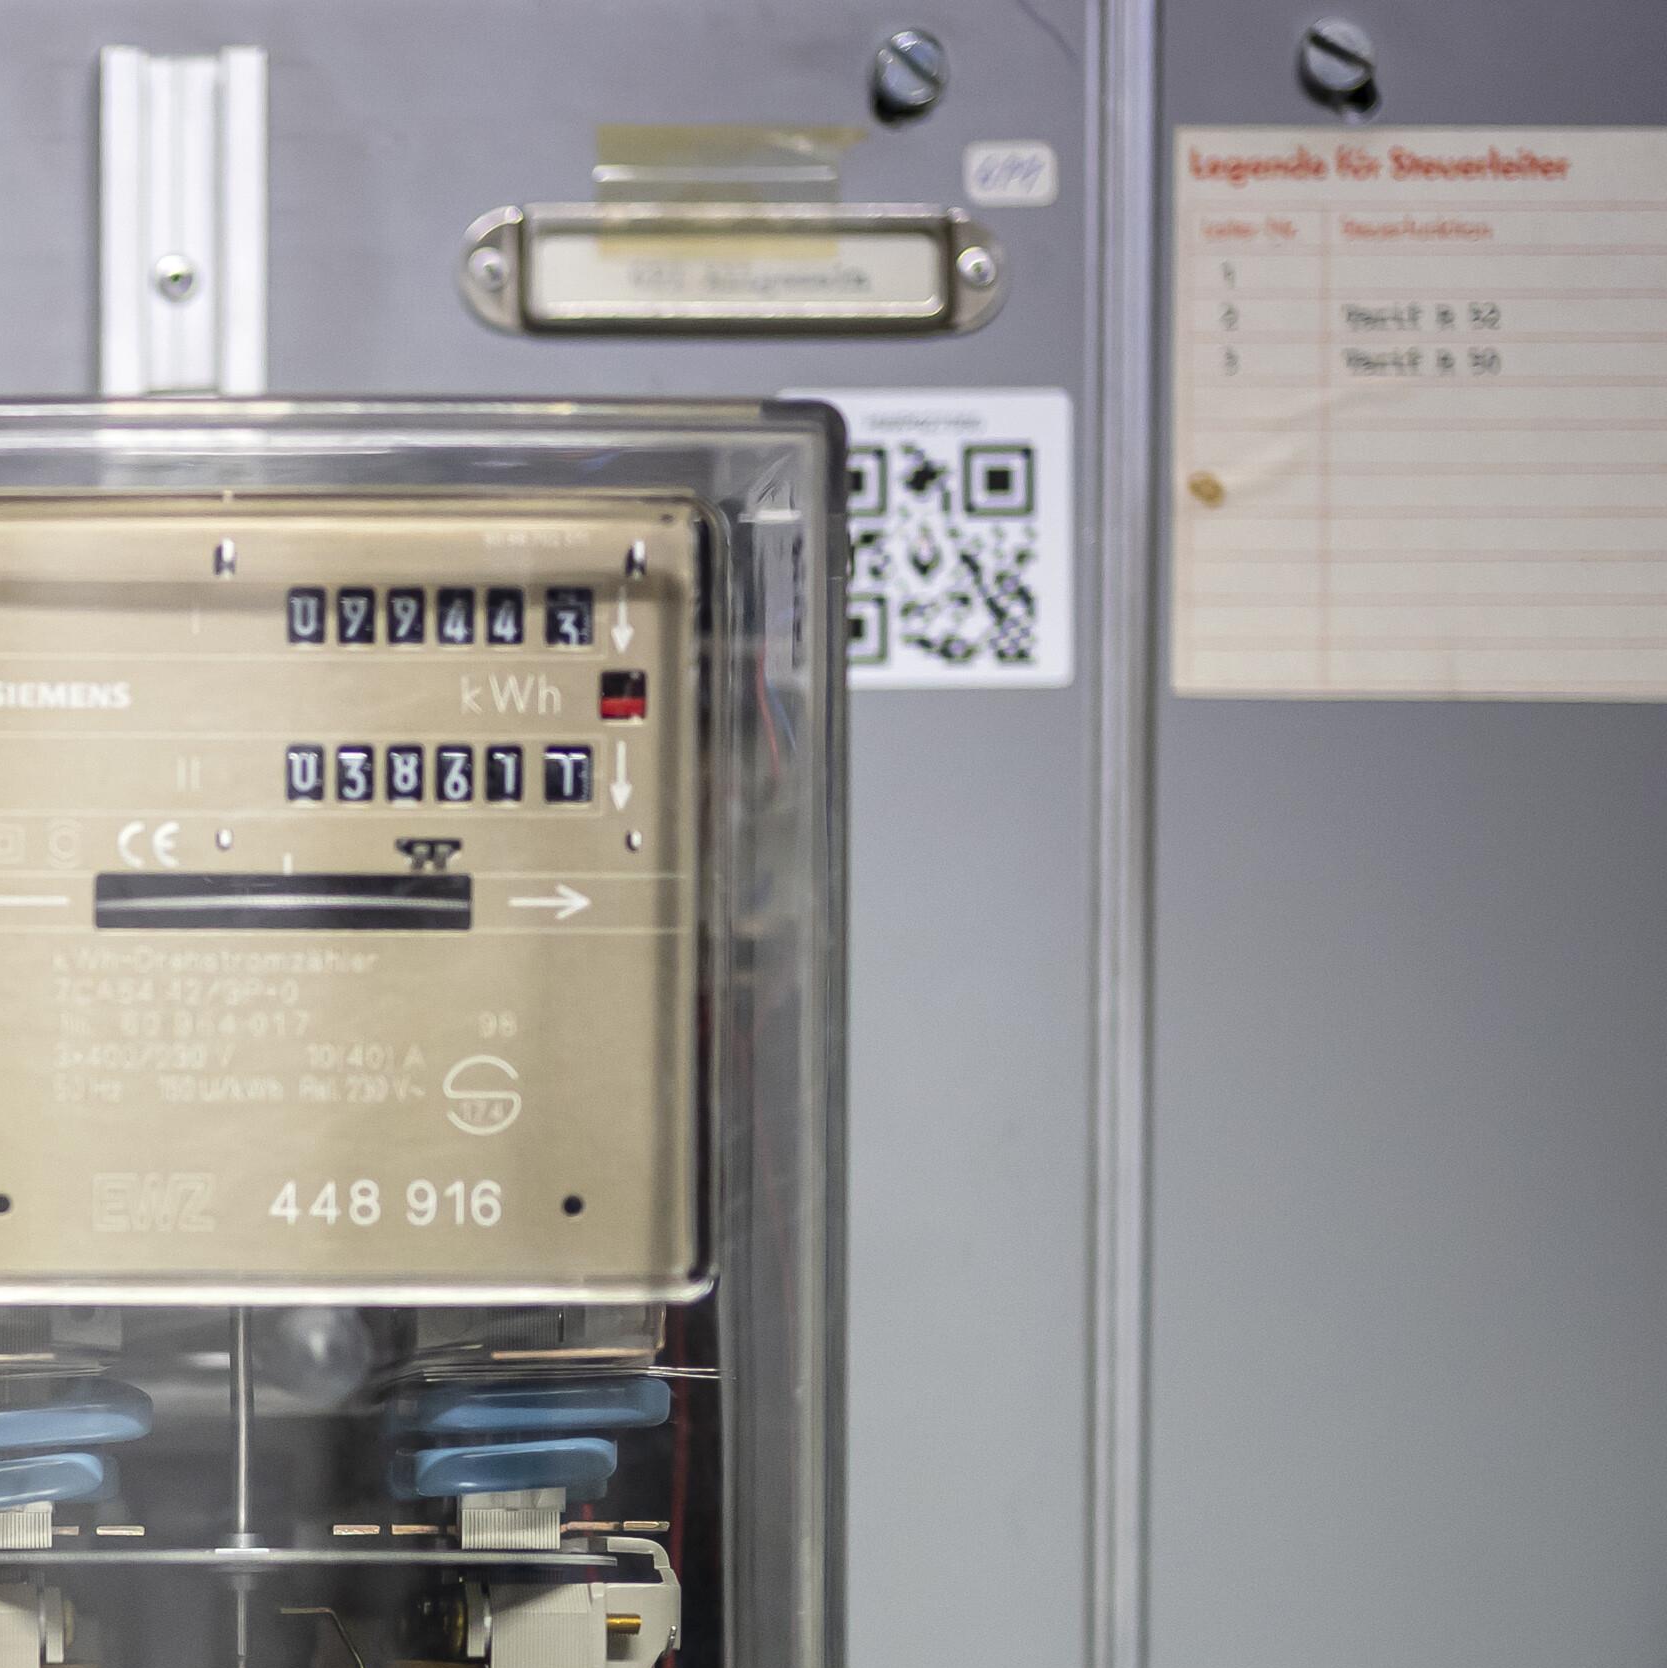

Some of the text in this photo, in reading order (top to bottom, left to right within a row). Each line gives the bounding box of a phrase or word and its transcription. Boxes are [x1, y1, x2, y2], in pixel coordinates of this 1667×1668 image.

[460, 672, 563, 714] kWh
[269, 1179, 380, 1226] 448
[405, 1179, 503, 1226] 916
